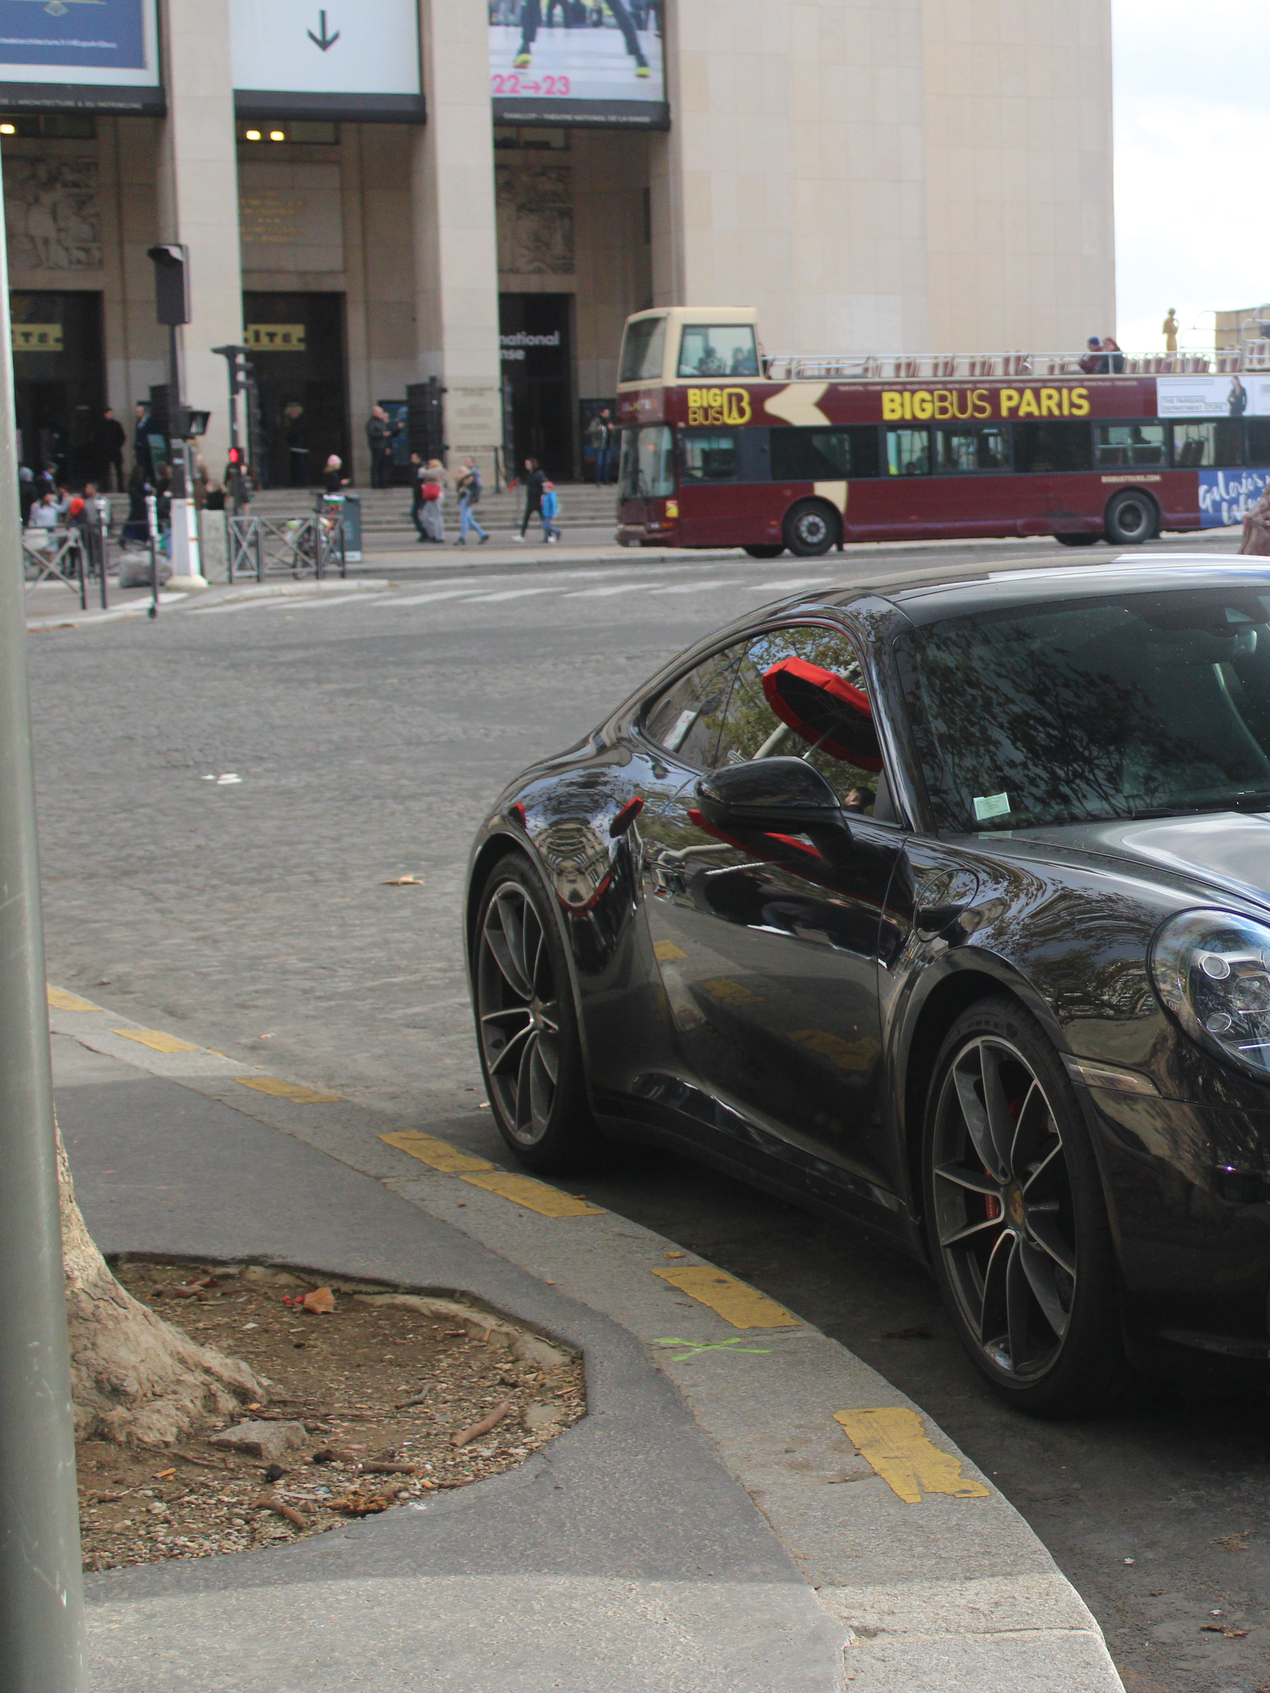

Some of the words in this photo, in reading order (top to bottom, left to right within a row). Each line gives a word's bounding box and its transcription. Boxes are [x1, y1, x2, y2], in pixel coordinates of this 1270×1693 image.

[492, 74, 520, 94] 22
[543, 76, 571, 95] 23
[499, 331, 560, 346] national
[688, 388, 722, 407] BIG
[1000, 387, 1091, 418] PARIS
[688, 407, 724, 425] BUS
